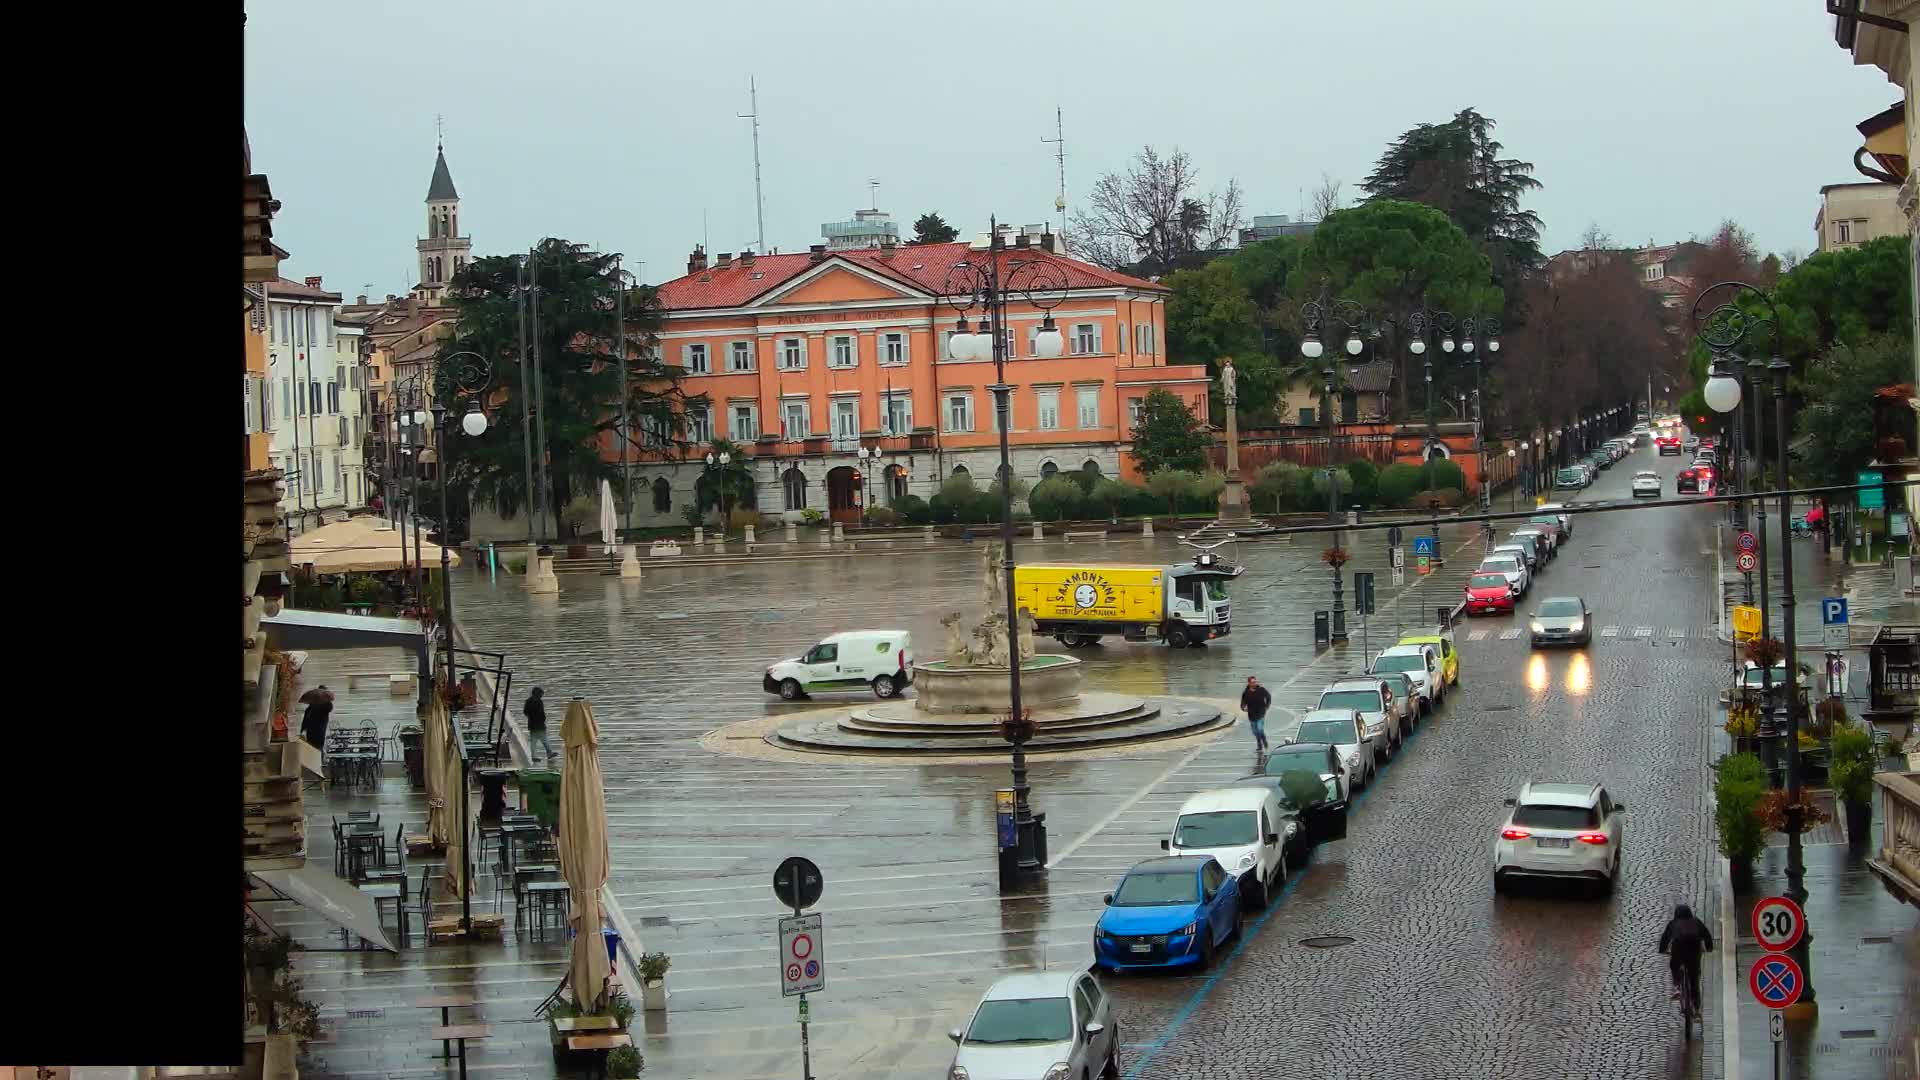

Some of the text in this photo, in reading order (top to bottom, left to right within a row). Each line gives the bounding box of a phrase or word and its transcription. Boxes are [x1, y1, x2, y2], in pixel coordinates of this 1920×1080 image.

[1741, 557, 1753, 567] 20
[1055, 571, 1117, 604] SAMMONTANA
[1828, 602, 1842, 621] P
[1761, 911, 1792, 938] 30
